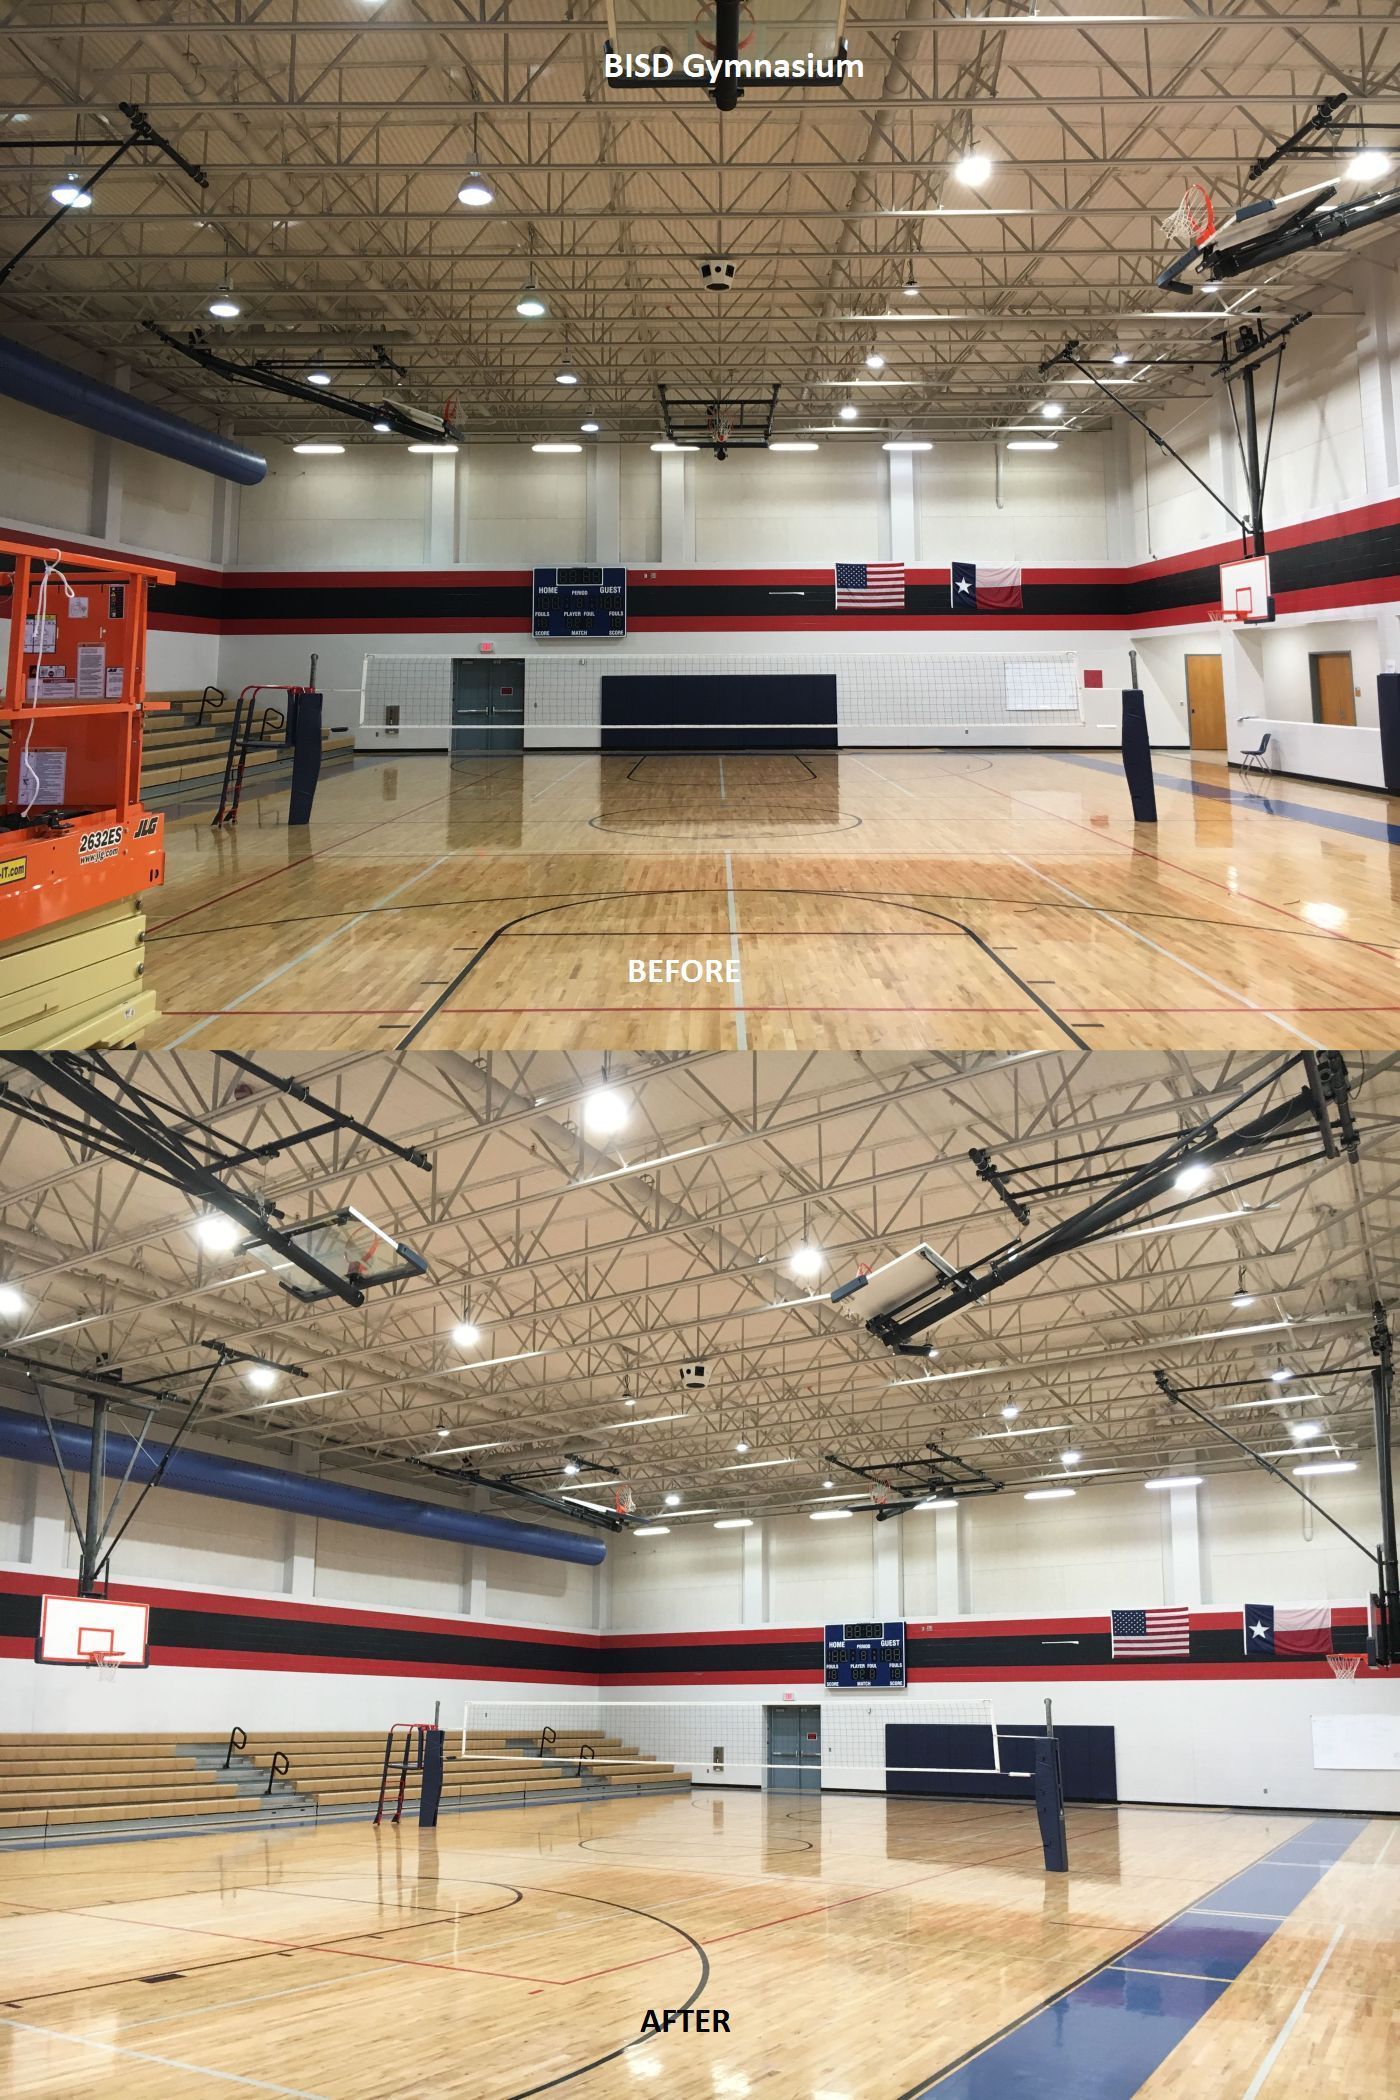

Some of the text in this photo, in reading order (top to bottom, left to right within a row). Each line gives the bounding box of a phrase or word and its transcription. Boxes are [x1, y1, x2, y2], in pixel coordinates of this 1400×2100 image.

[538, 586, 559, 594] HOME
[599, 586, 622, 594] GUEST
[134, 817, 158, 838] JLG
[79, 826, 122, 853] 2632ES
[80, 848, 118, 864] www.jlg.com
[880, 1639, 900, 1647] GUEST
